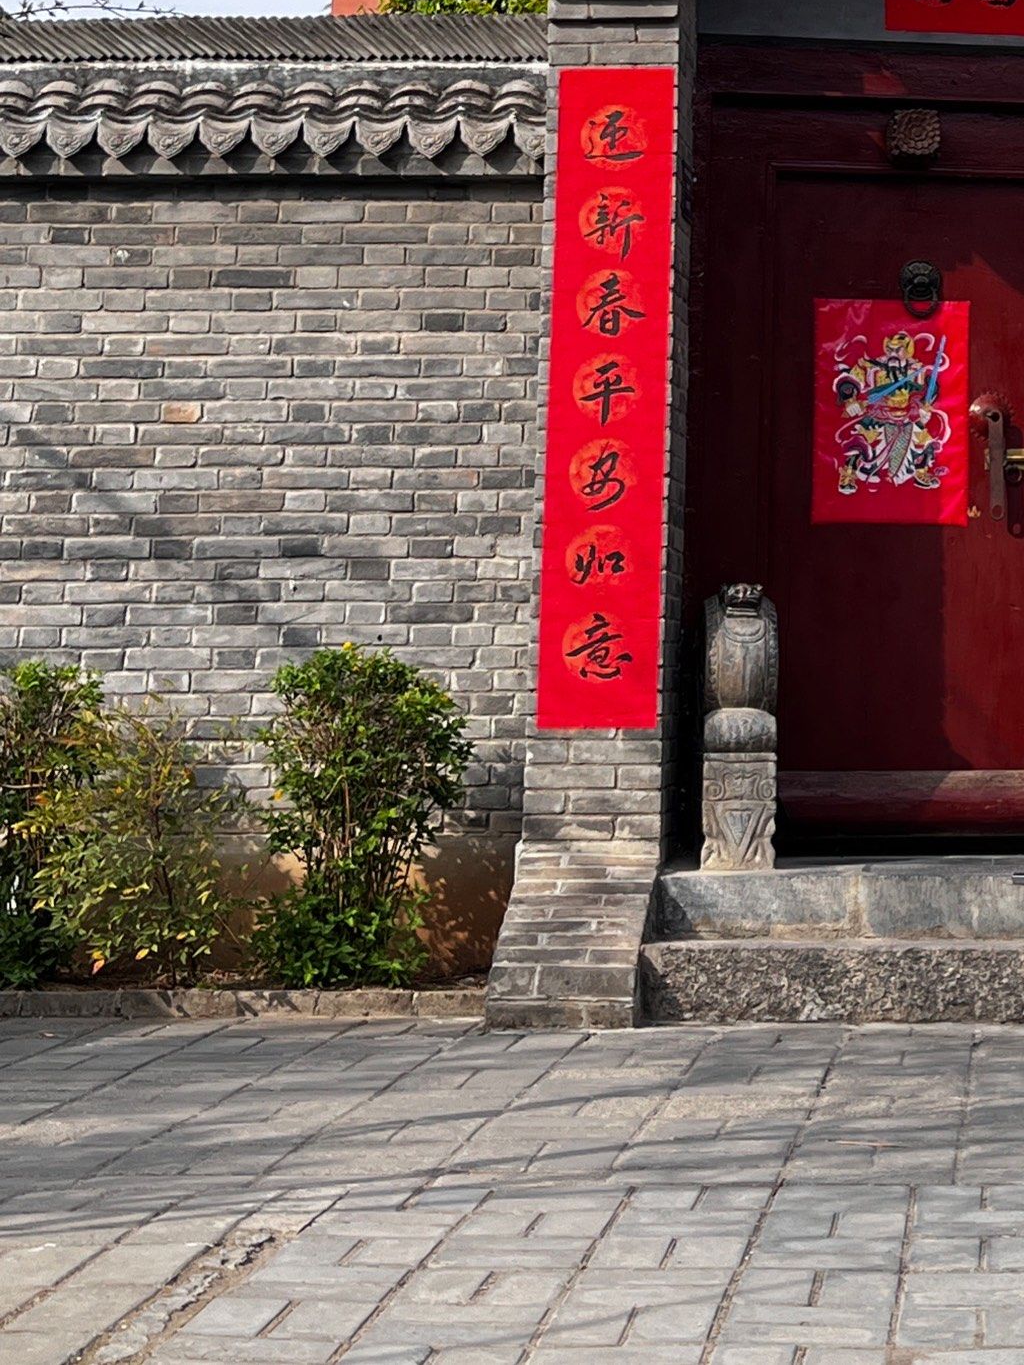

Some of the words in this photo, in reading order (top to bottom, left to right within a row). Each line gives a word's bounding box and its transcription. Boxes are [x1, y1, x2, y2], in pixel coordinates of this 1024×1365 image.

[566, 110, 647, 680] 迎新春平安如意
